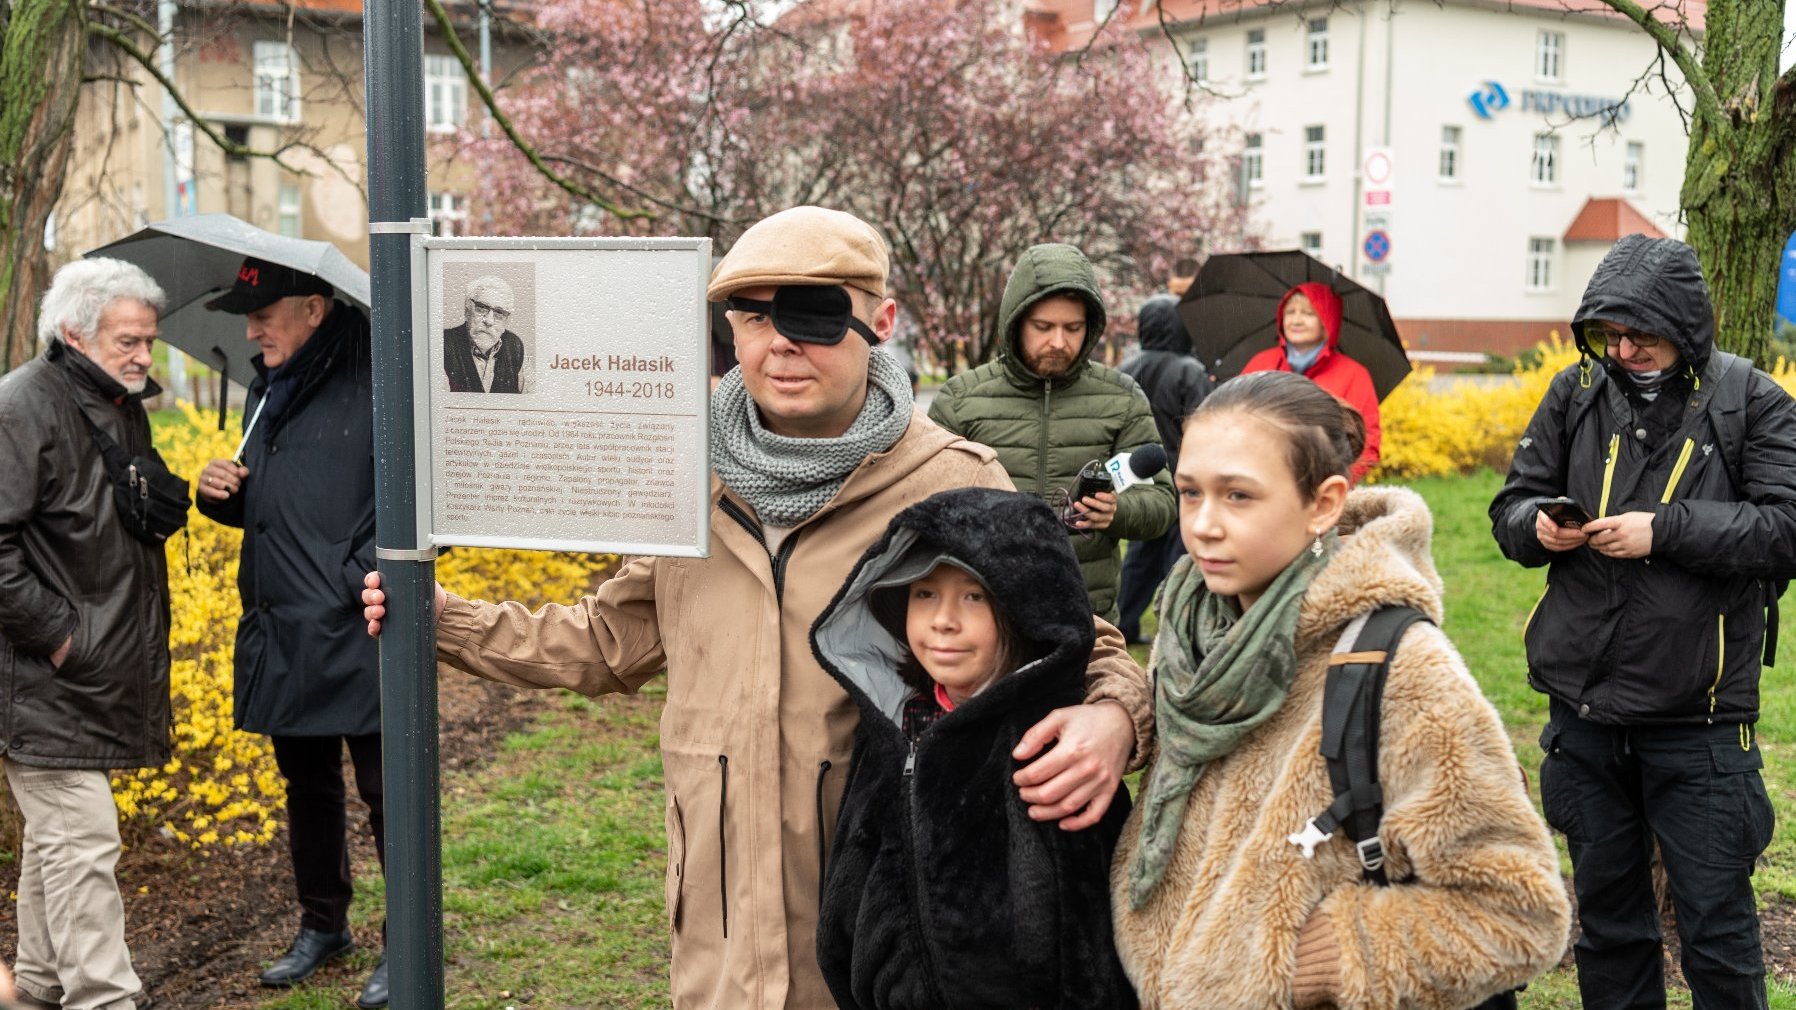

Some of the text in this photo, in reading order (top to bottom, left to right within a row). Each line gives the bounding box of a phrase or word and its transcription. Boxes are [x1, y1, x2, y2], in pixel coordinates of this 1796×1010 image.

[550, 354, 674, 372] Jacek Hałasik
[585, 381, 674, 399] 1944-2018
[599, 432, 636, 441] pracownik
[445, 437, 479, 447] Polskiego
[554, 442, 573, 451] przez
[576, 442, 590, 450] lata
[593, 443, 652, 453] współpracownik
[655, 445, 674, 455] stacji
[576, 453, 597, 461] Autor
[601, 454, 621, 462] wielu
[657, 457, 674, 465] oraz
[535, 463, 593, 474] wielkopolskiego
[657, 468, 674, 476] oraz
[445, 470, 471, 479] dziejów
[645, 479, 674, 487] znawca
[489, 483, 511, 492] gwary
